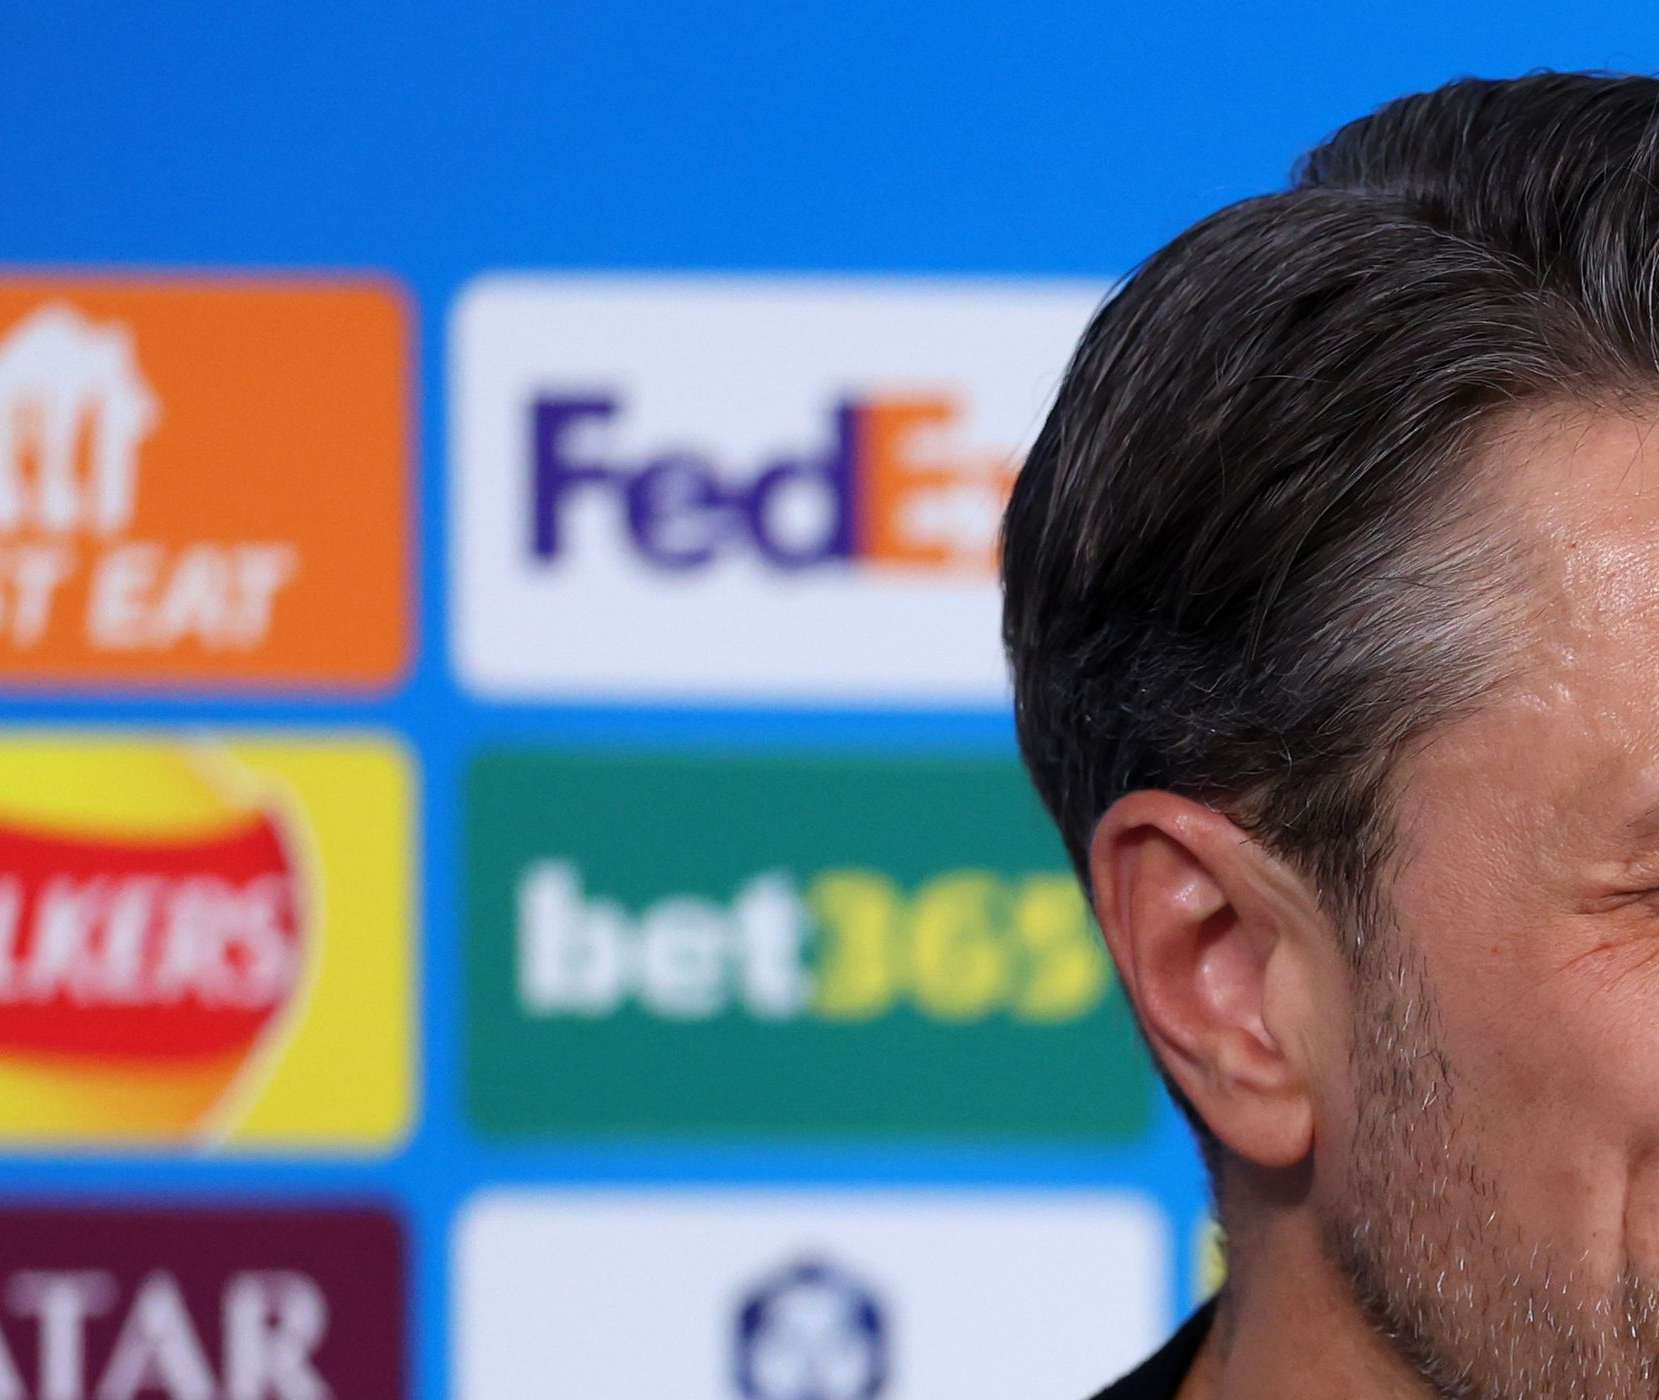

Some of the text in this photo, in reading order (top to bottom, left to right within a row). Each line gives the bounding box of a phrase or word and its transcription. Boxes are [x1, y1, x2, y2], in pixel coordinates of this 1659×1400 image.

[527, 383, 1022, 570] FedE
[84, 540, 302, 650] EAT
[515, 858, 1112, 1022] bet365
